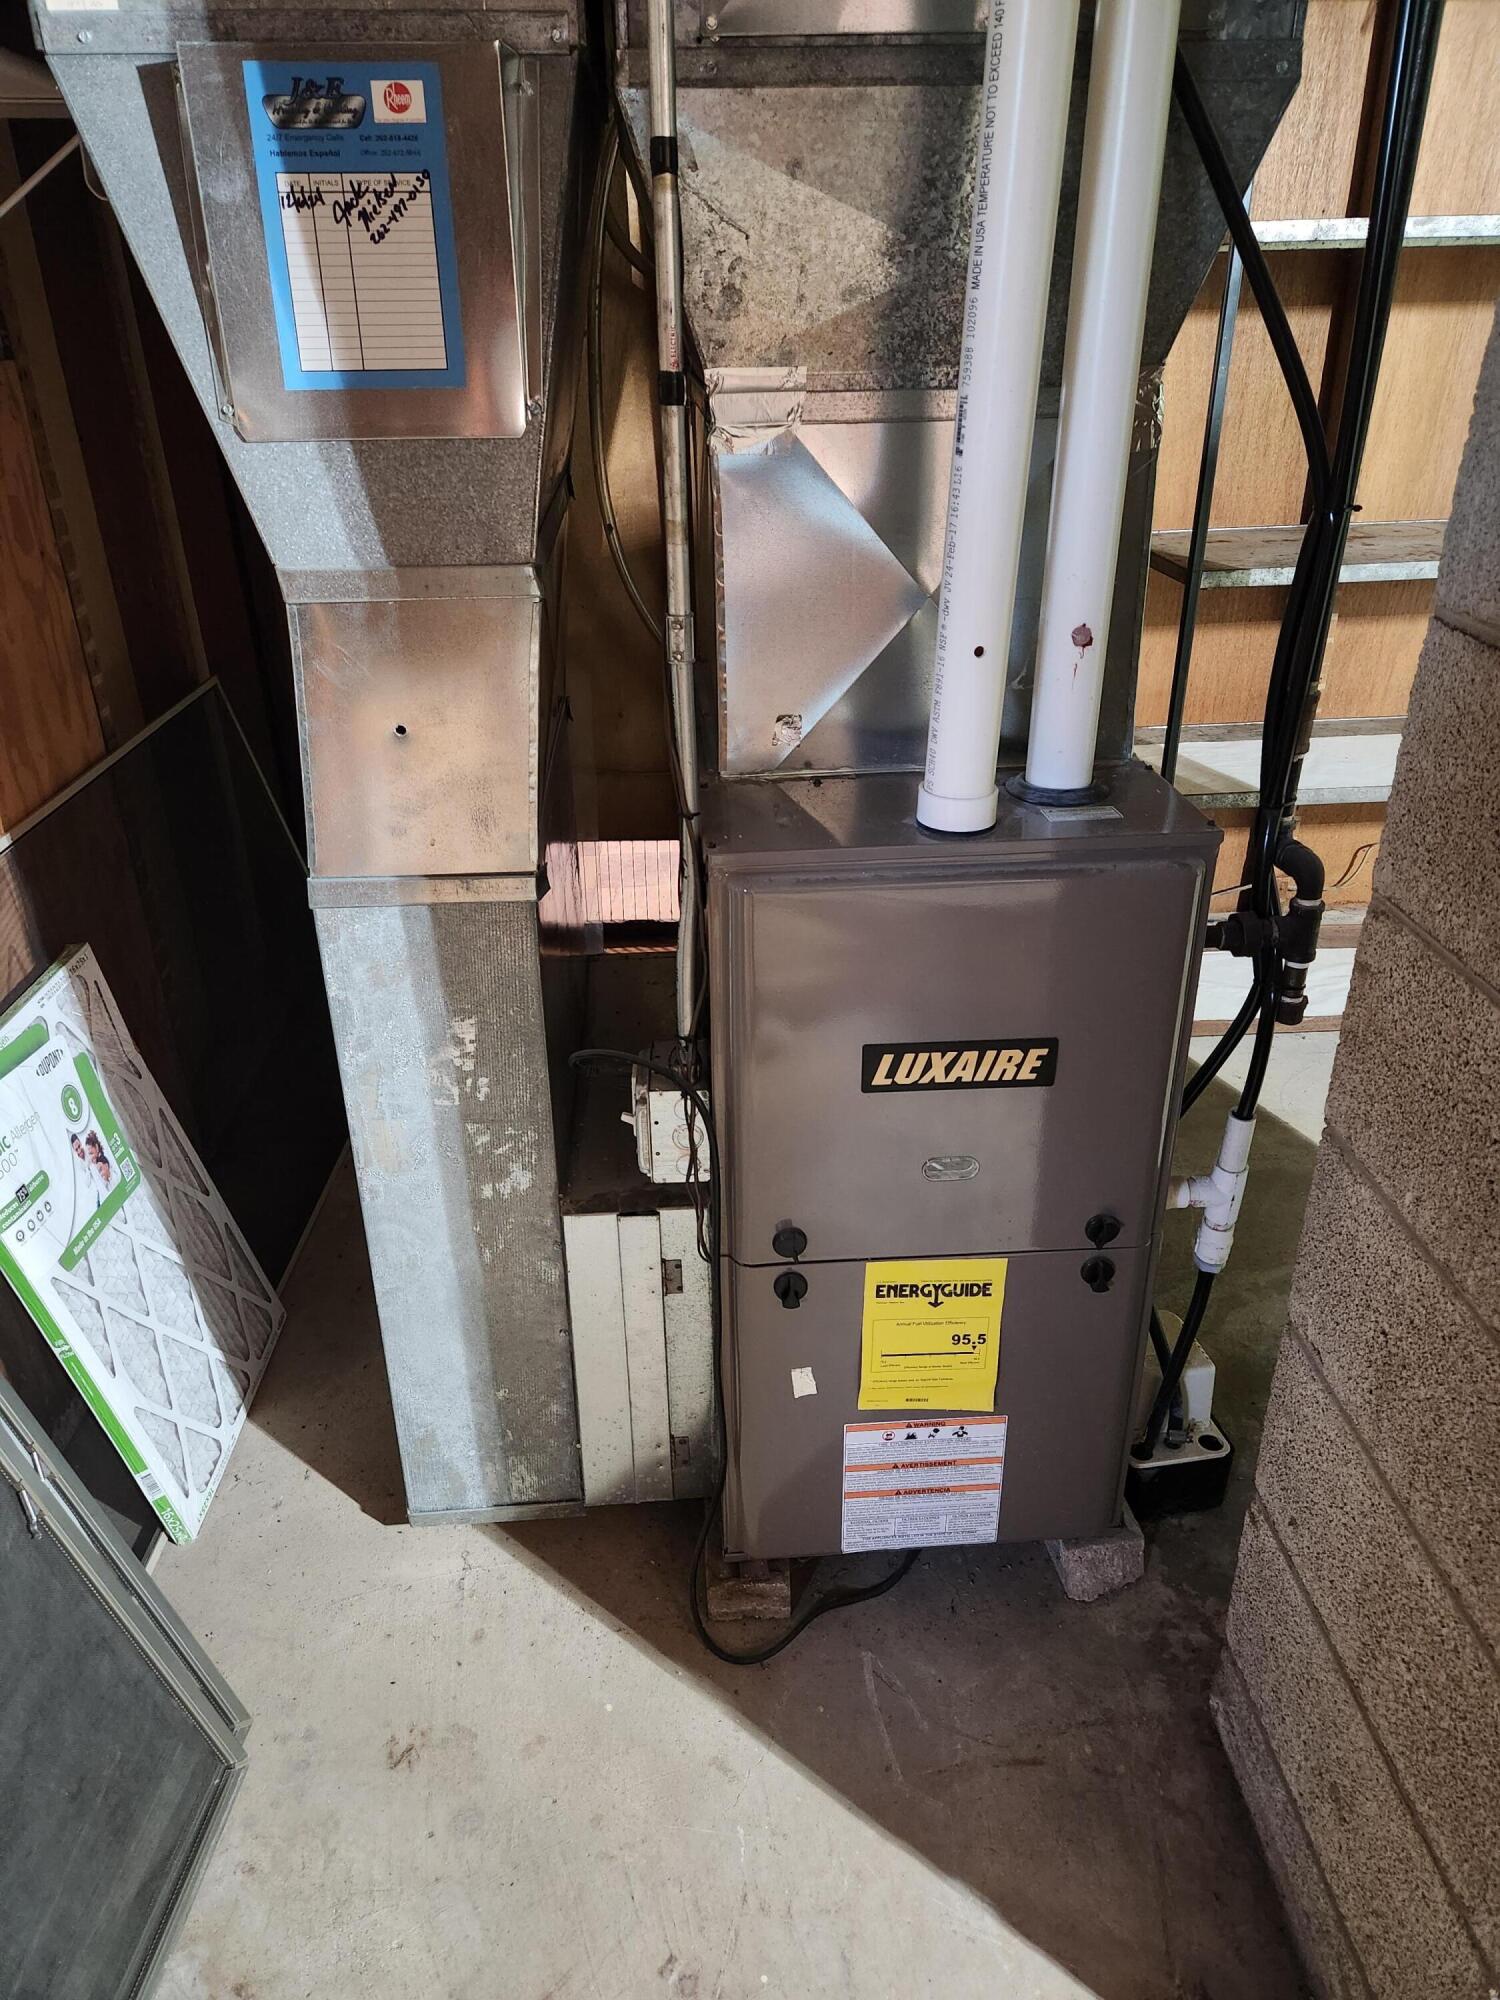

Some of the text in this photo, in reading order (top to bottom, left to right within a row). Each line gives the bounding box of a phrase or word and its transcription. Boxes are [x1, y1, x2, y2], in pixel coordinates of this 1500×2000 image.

[993, 8, 1005, 29] 140
[988, 32, 1003, 83] EXCEED
[385, 81, 413, 111] Rheem
[986, 84, 999, 100] TO
[984, 105, 997, 129] NOT
[313, 179, 339, 187] INITIALS
[384, 179, 411, 187] SEVICE
[976, 130, 995, 217] TEMPERATURE
[975, 220, 986, 243] USA
[973, 246, 984, 257] IN
[970, 259, 983, 290] MADE
[966, 296, 979, 339] 102096
[932, 699, 941, 724] ASTM
[37, 1048, 62, 1077] DUPONT
[871, 1048, 1049, 1086] LUXAIRE
[68, 1097, 79, 1115] 8
[875, 1282, 993, 1301] ENERGYGUIDE
[951, 1333, 987, 1346] 95.5
[913, 1420, 947, 1428] WARNING
[900, 1460, 957, 1469] AVERTISSEMENT
[902, 1487, 951, 1495] ADVERTENCIA
